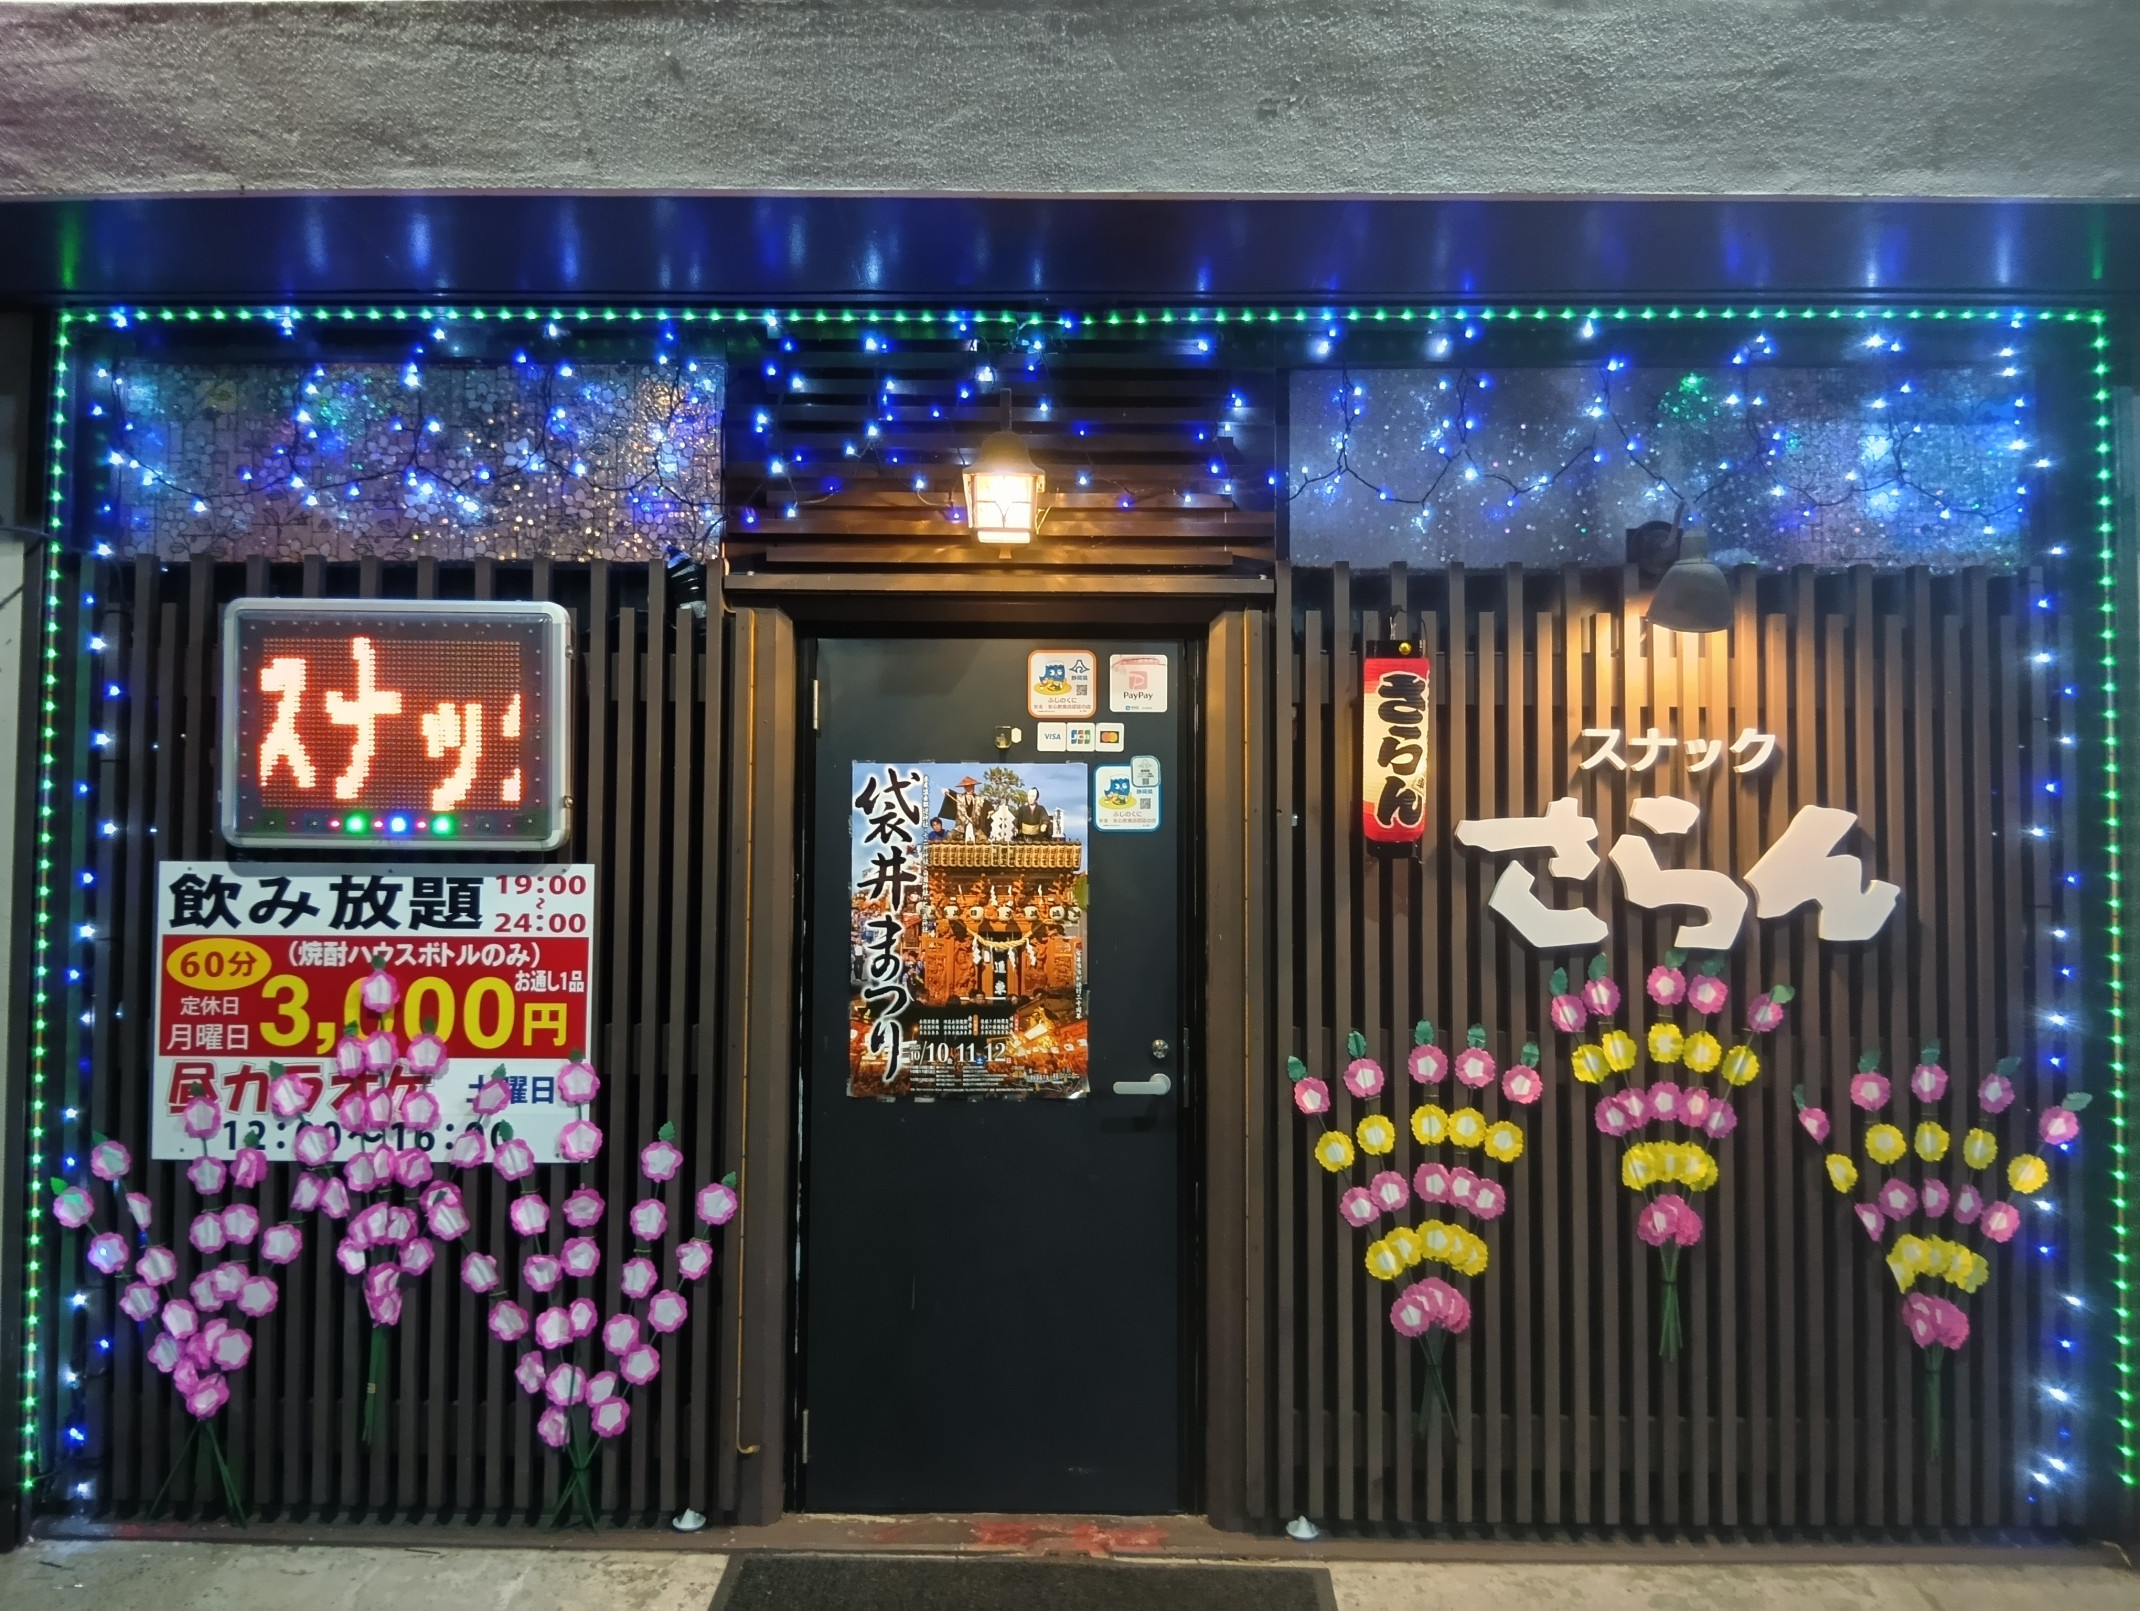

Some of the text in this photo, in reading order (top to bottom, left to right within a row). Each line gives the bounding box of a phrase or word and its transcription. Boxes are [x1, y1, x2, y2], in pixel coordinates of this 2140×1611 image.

[1123, 691, 1153, 700] PayPay
[260, 636, 520, 811] スナッ
[1044, 732, 1061, 741] VISA
[1579, 727, 1776, 773] スナック
[496, 875, 586, 895] 19:00
[1454, 796, 1900, 949] さらん
[169, 873, 484, 931] 飲み放題
[494, 913, 586, 933] 24:00
[855, 767, 920, 1081] 袋井まつり
[180, 951, 258, 978] 60分
[288, 940, 541, 967] (焼酎ハウスボトルのみ)
[514, 970, 585, 993] お通し1品
[180, 996, 239, 1016] 定休日
[167, 1023, 249, 1051] 月曜日
